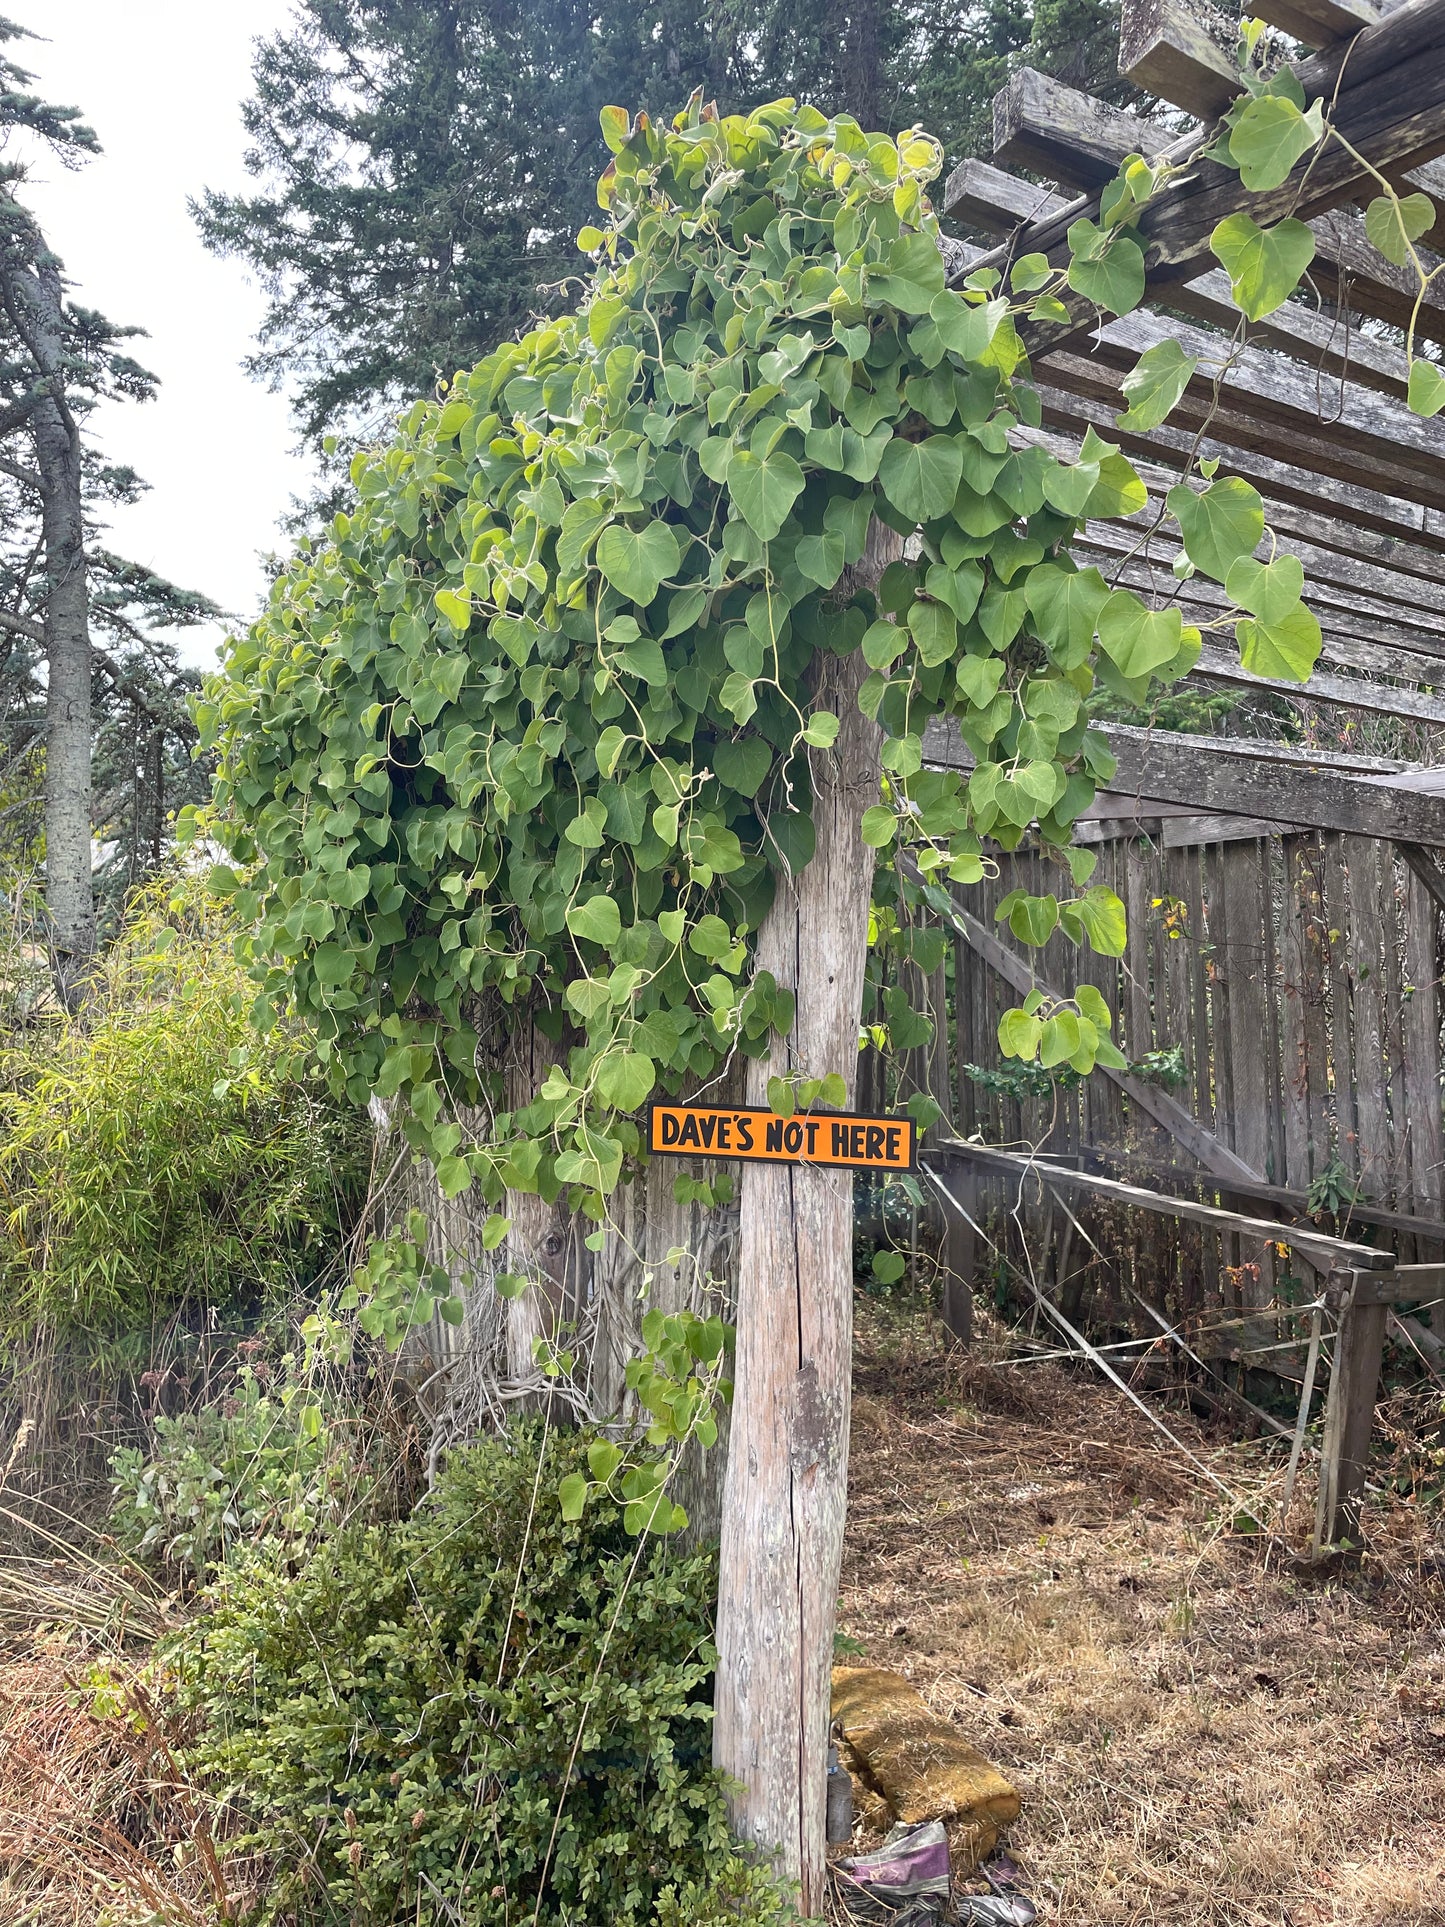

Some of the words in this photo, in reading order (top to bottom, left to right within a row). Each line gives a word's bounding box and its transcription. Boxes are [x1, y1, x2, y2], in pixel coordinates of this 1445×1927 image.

[662, 1113, 753, 1151] DAVE'S
[766, 1119, 819, 1154] NOT
[831, 1123, 901, 1160] HERE
